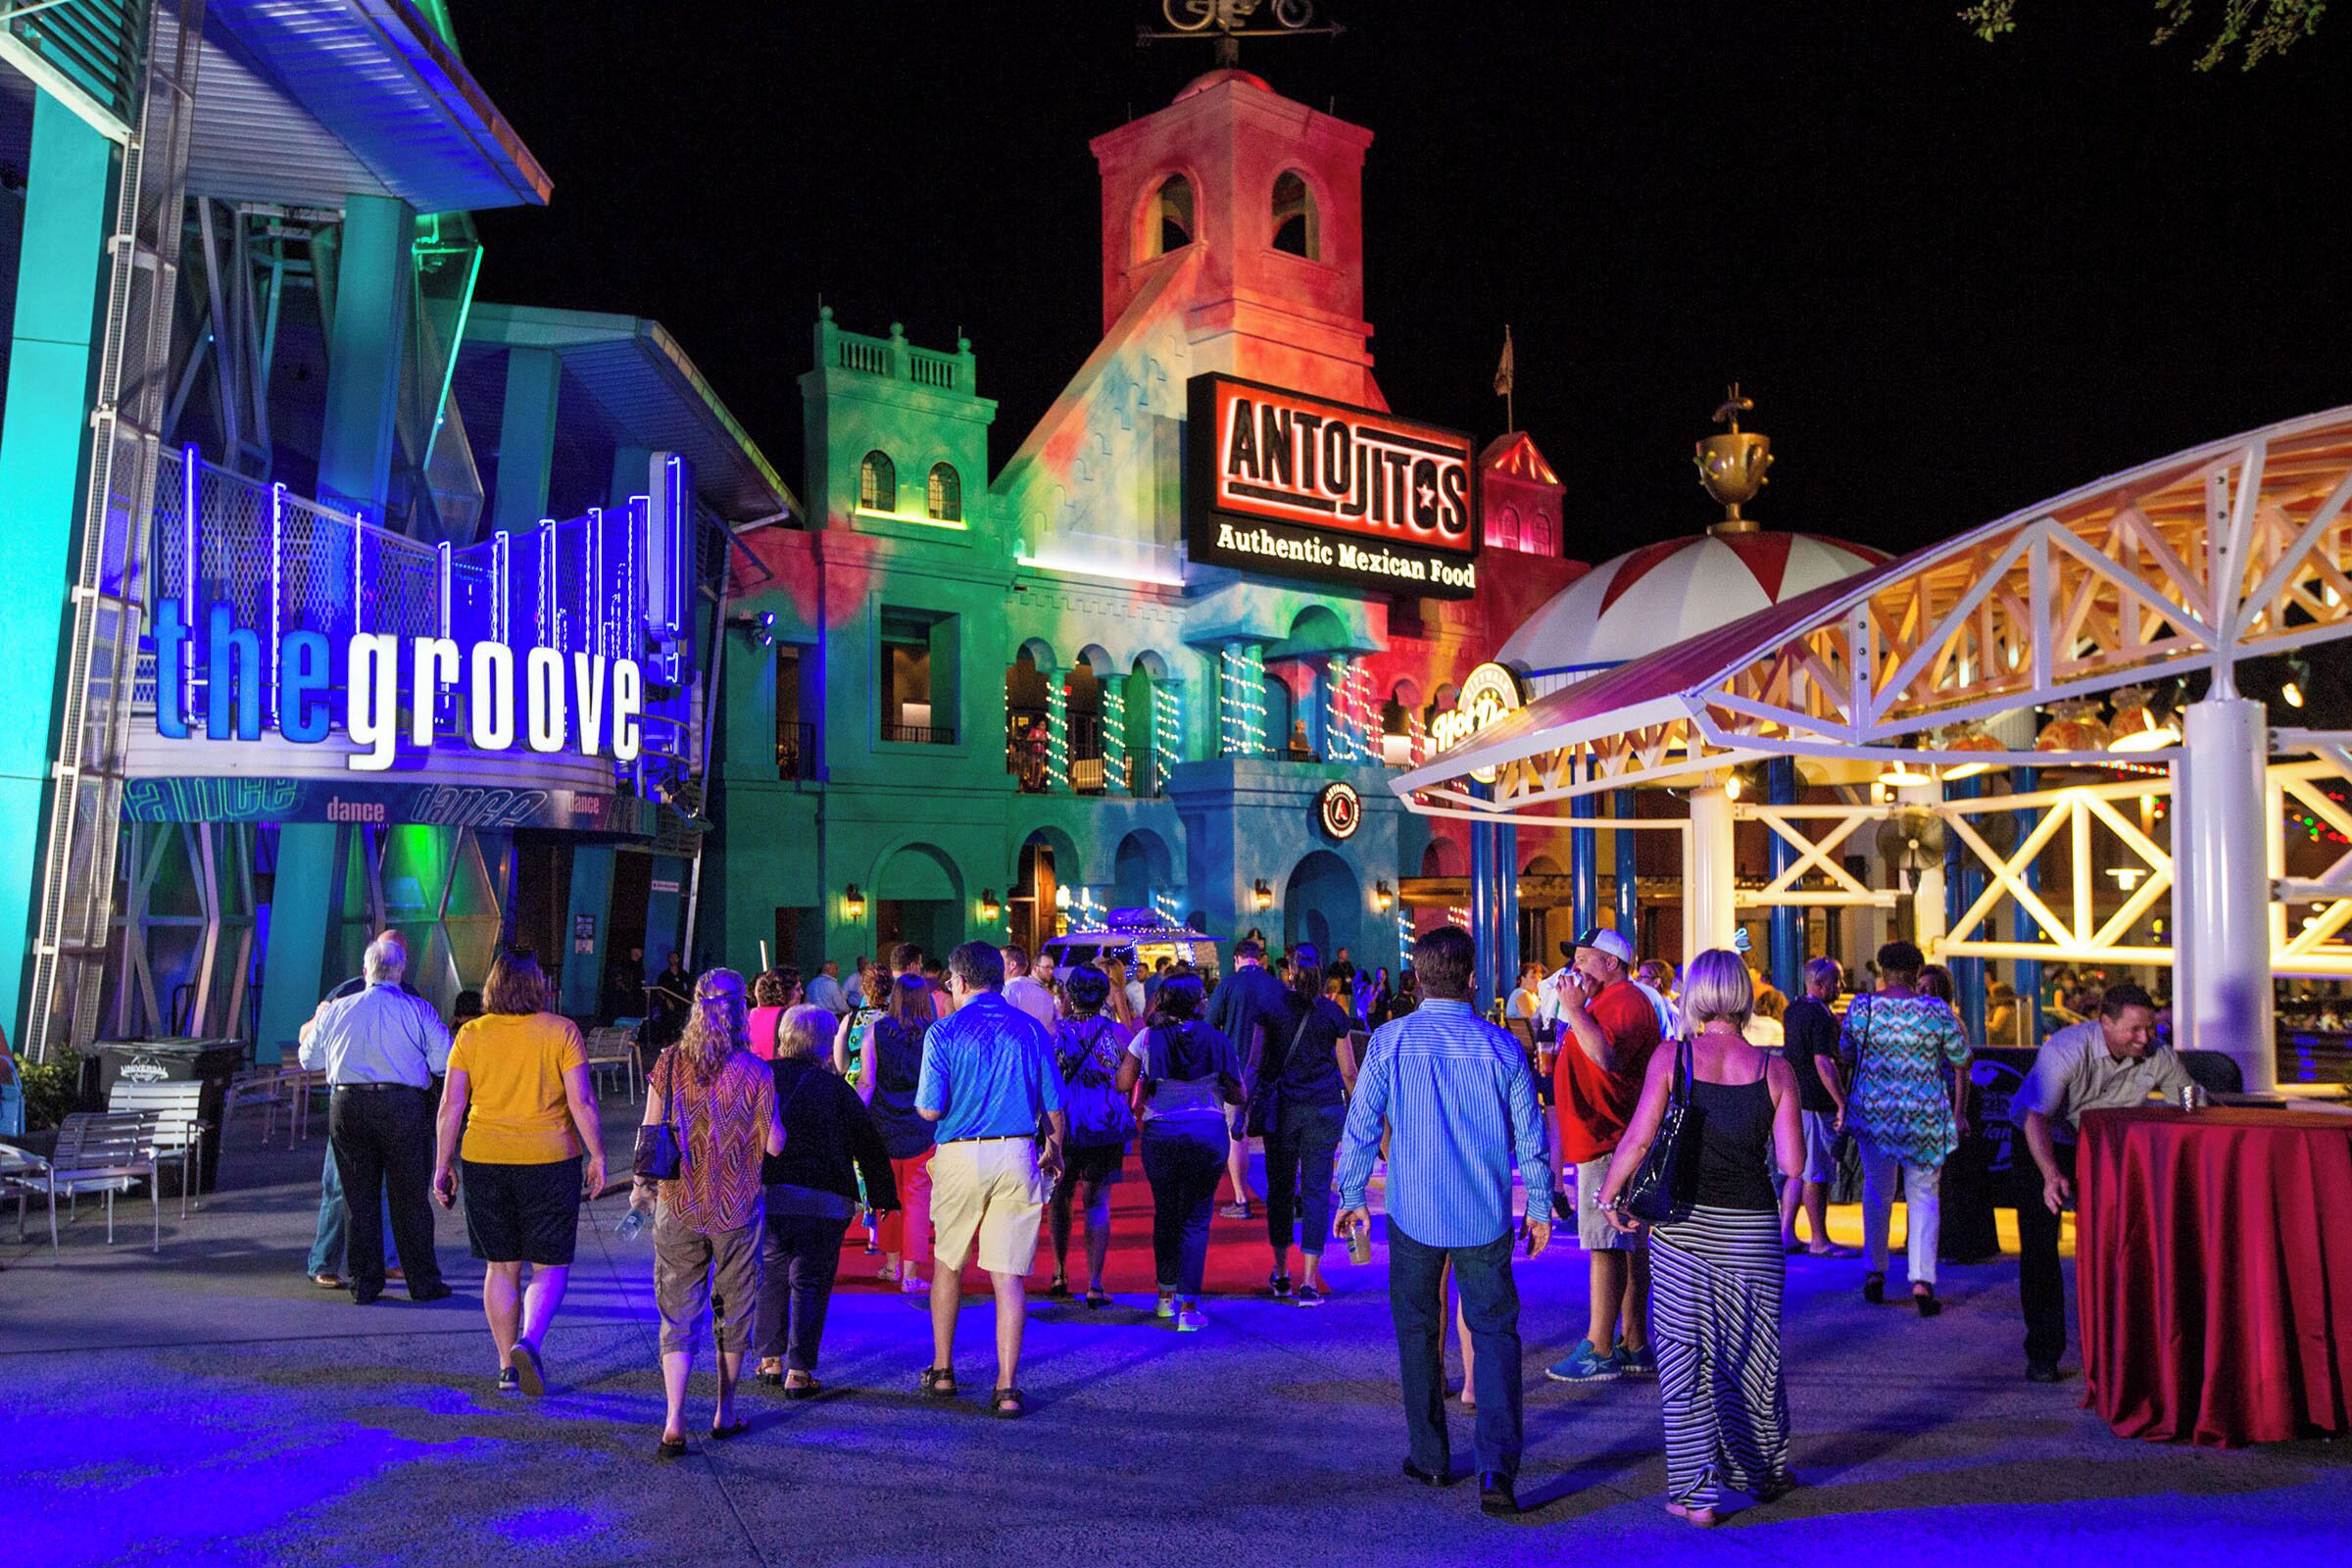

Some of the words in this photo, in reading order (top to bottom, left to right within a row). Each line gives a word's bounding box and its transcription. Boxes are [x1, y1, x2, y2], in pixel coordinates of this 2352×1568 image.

[1226, 397, 1469, 536] ANTOJITOS
[1216, 523, 1333, 565] Authentic
[1338, 543, 1426, 580] Mexican
[1430, 558, 1476, 589] Food
[153, 597, 330, 743] the
[347, 632, 642, 772] groove
[1432, 704, 1475, 753] Hot
[122, 777, 299, 822] ance
[327, 795, 385, 822] dance
[411, 783, 549, 827] dance
[567, 790, 601, 814] dance
